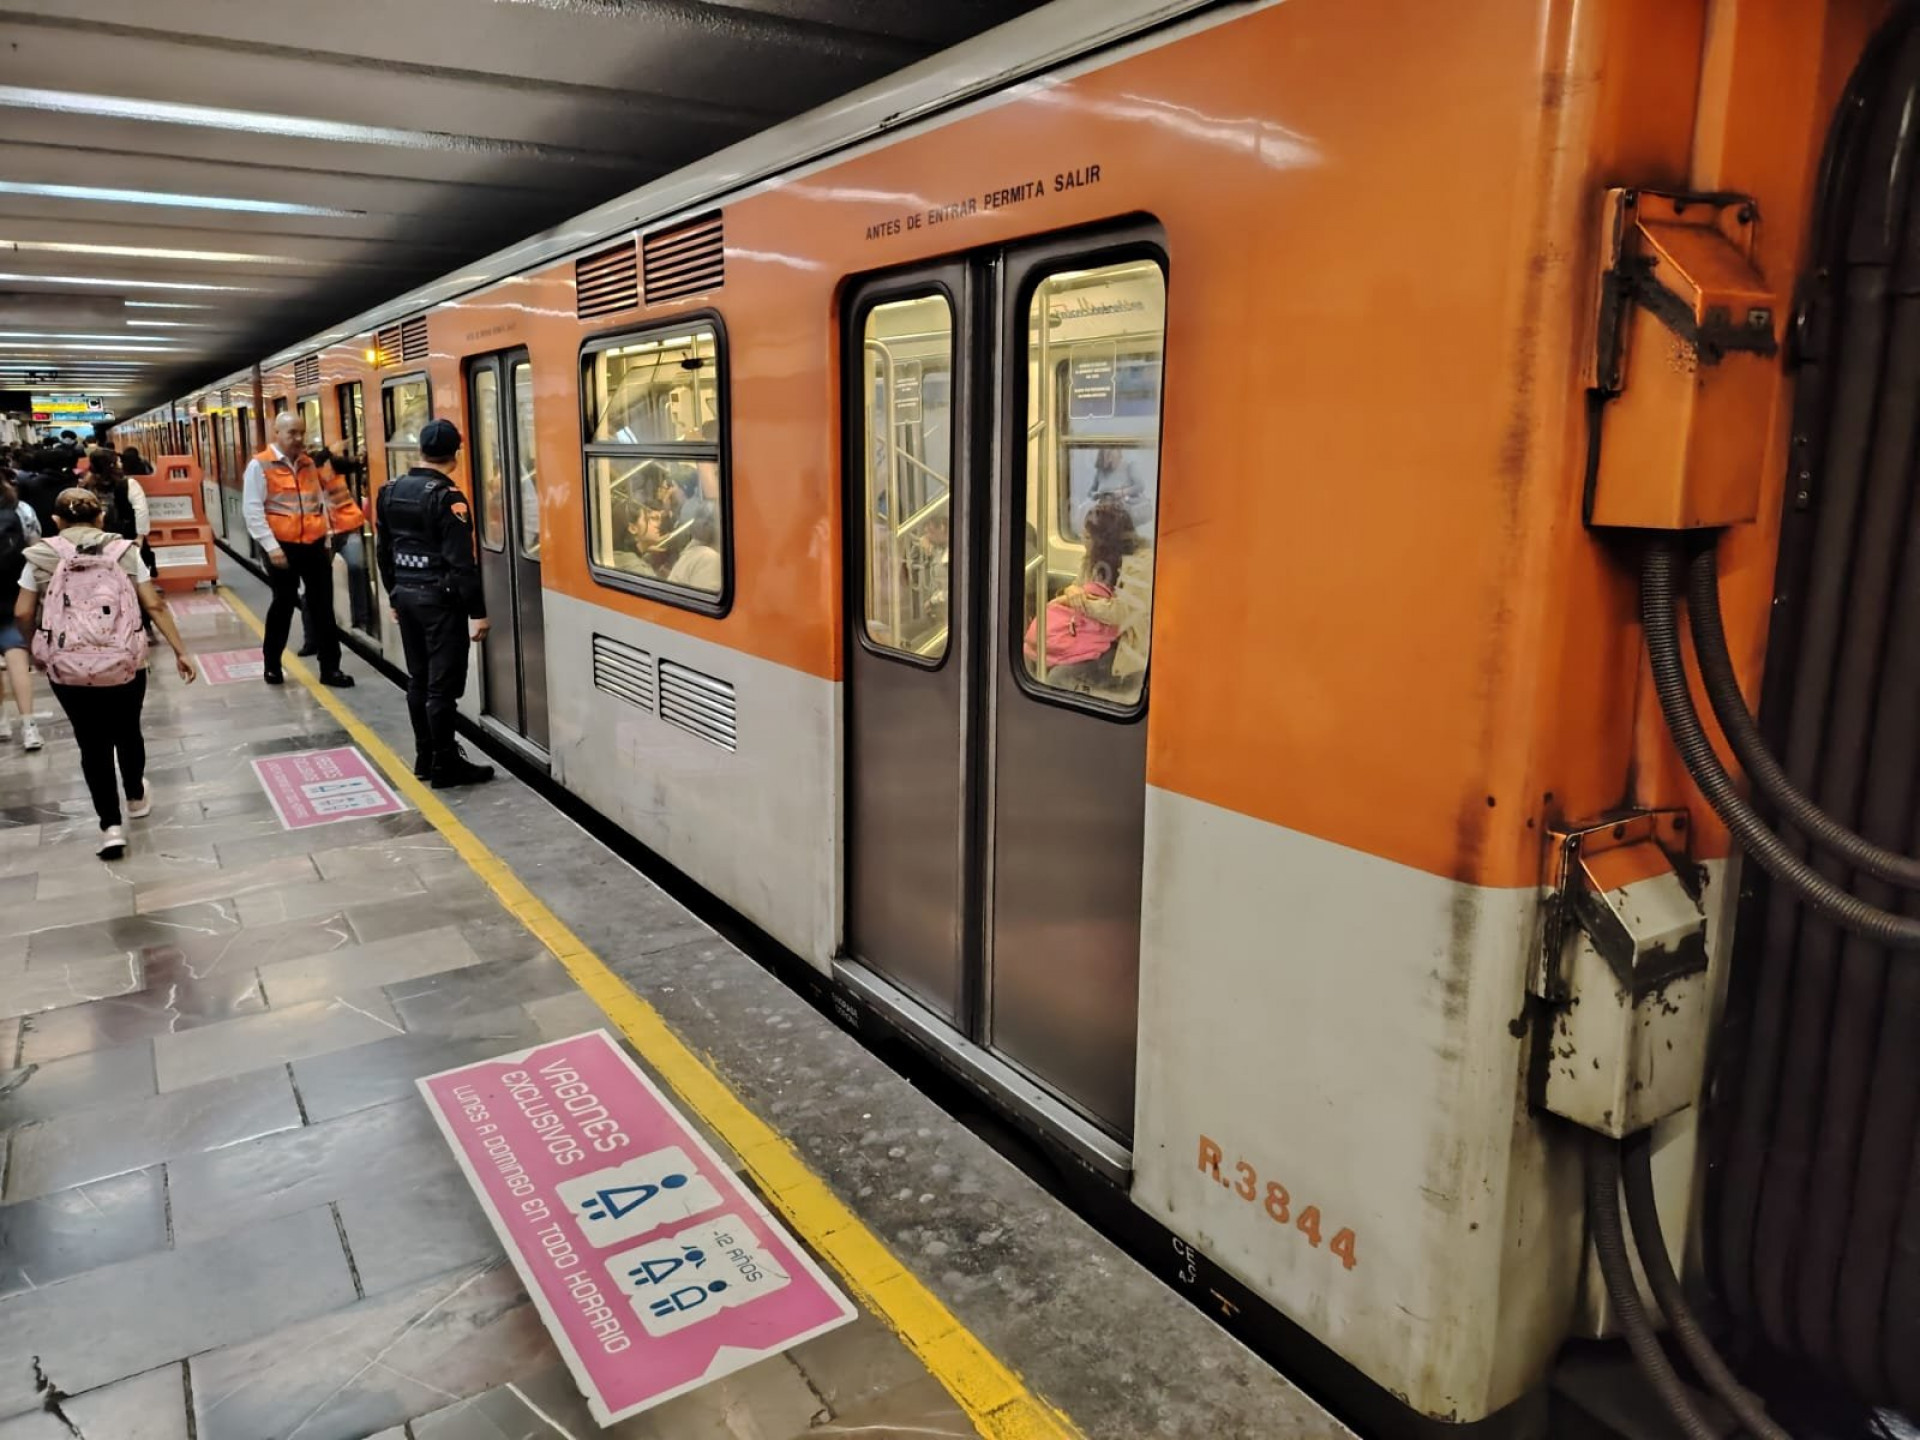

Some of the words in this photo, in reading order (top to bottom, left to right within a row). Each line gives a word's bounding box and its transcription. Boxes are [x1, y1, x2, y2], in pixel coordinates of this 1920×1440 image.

[866, 219, 901, 240] ANTES
[907, 214, 922, 230] DE
[928, 198, 977, 225] ENTRAR
[984, 179, 1045, 210] PERMITA
[1054, 164, 1101, 192] SALIR
[452, 1084, 490, 1123] LUNES
[475, 1123, 498, 1136] A
[500, 1069, 585, 1165] EXCLUSIVOS
[539, 1057, 630, 1152] VAGONES
[482, 1134, 535, 1197] DOMINGO
[520, 1198, 551, 1224] EN
[1197, 1133, 1357, 1271] R.3844
[536, 1221, 579, 1269] TODO
[713, 1231, 735, 1248] -12
[725, 1247, 764, 1283] AÑOS
[563, 1269, 631, 1354] HORARIO
